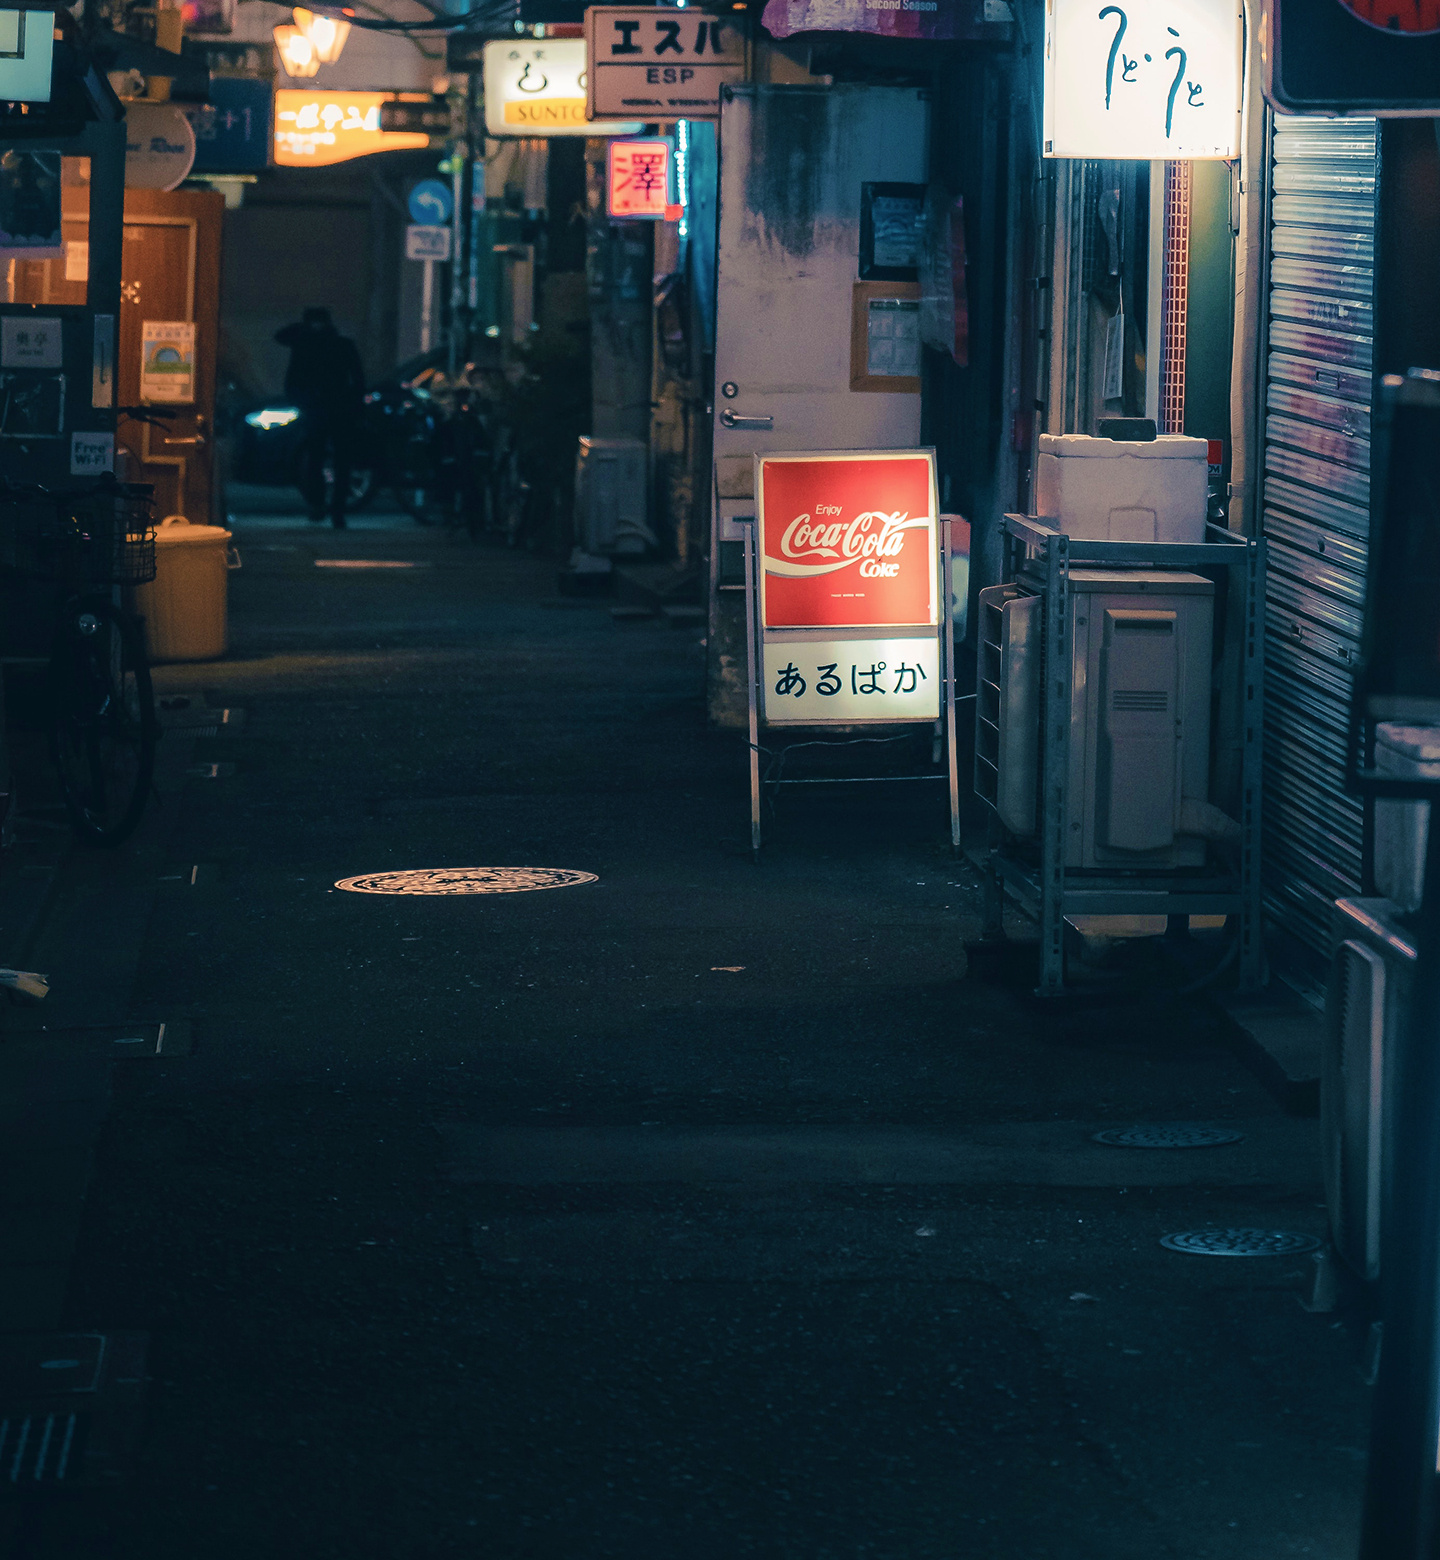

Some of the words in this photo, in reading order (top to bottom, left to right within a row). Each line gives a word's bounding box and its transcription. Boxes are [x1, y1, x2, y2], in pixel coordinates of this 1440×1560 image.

[646, 69, 694, 84] ESP
[74, 441, 106, 453] Free
[815, 504, 843, 517] Enjoy
[780, 511, 909, 559] Coca-Cola
[859, 558, 900, 578] Coke
[774, 660, 928, 699] あるぱか
